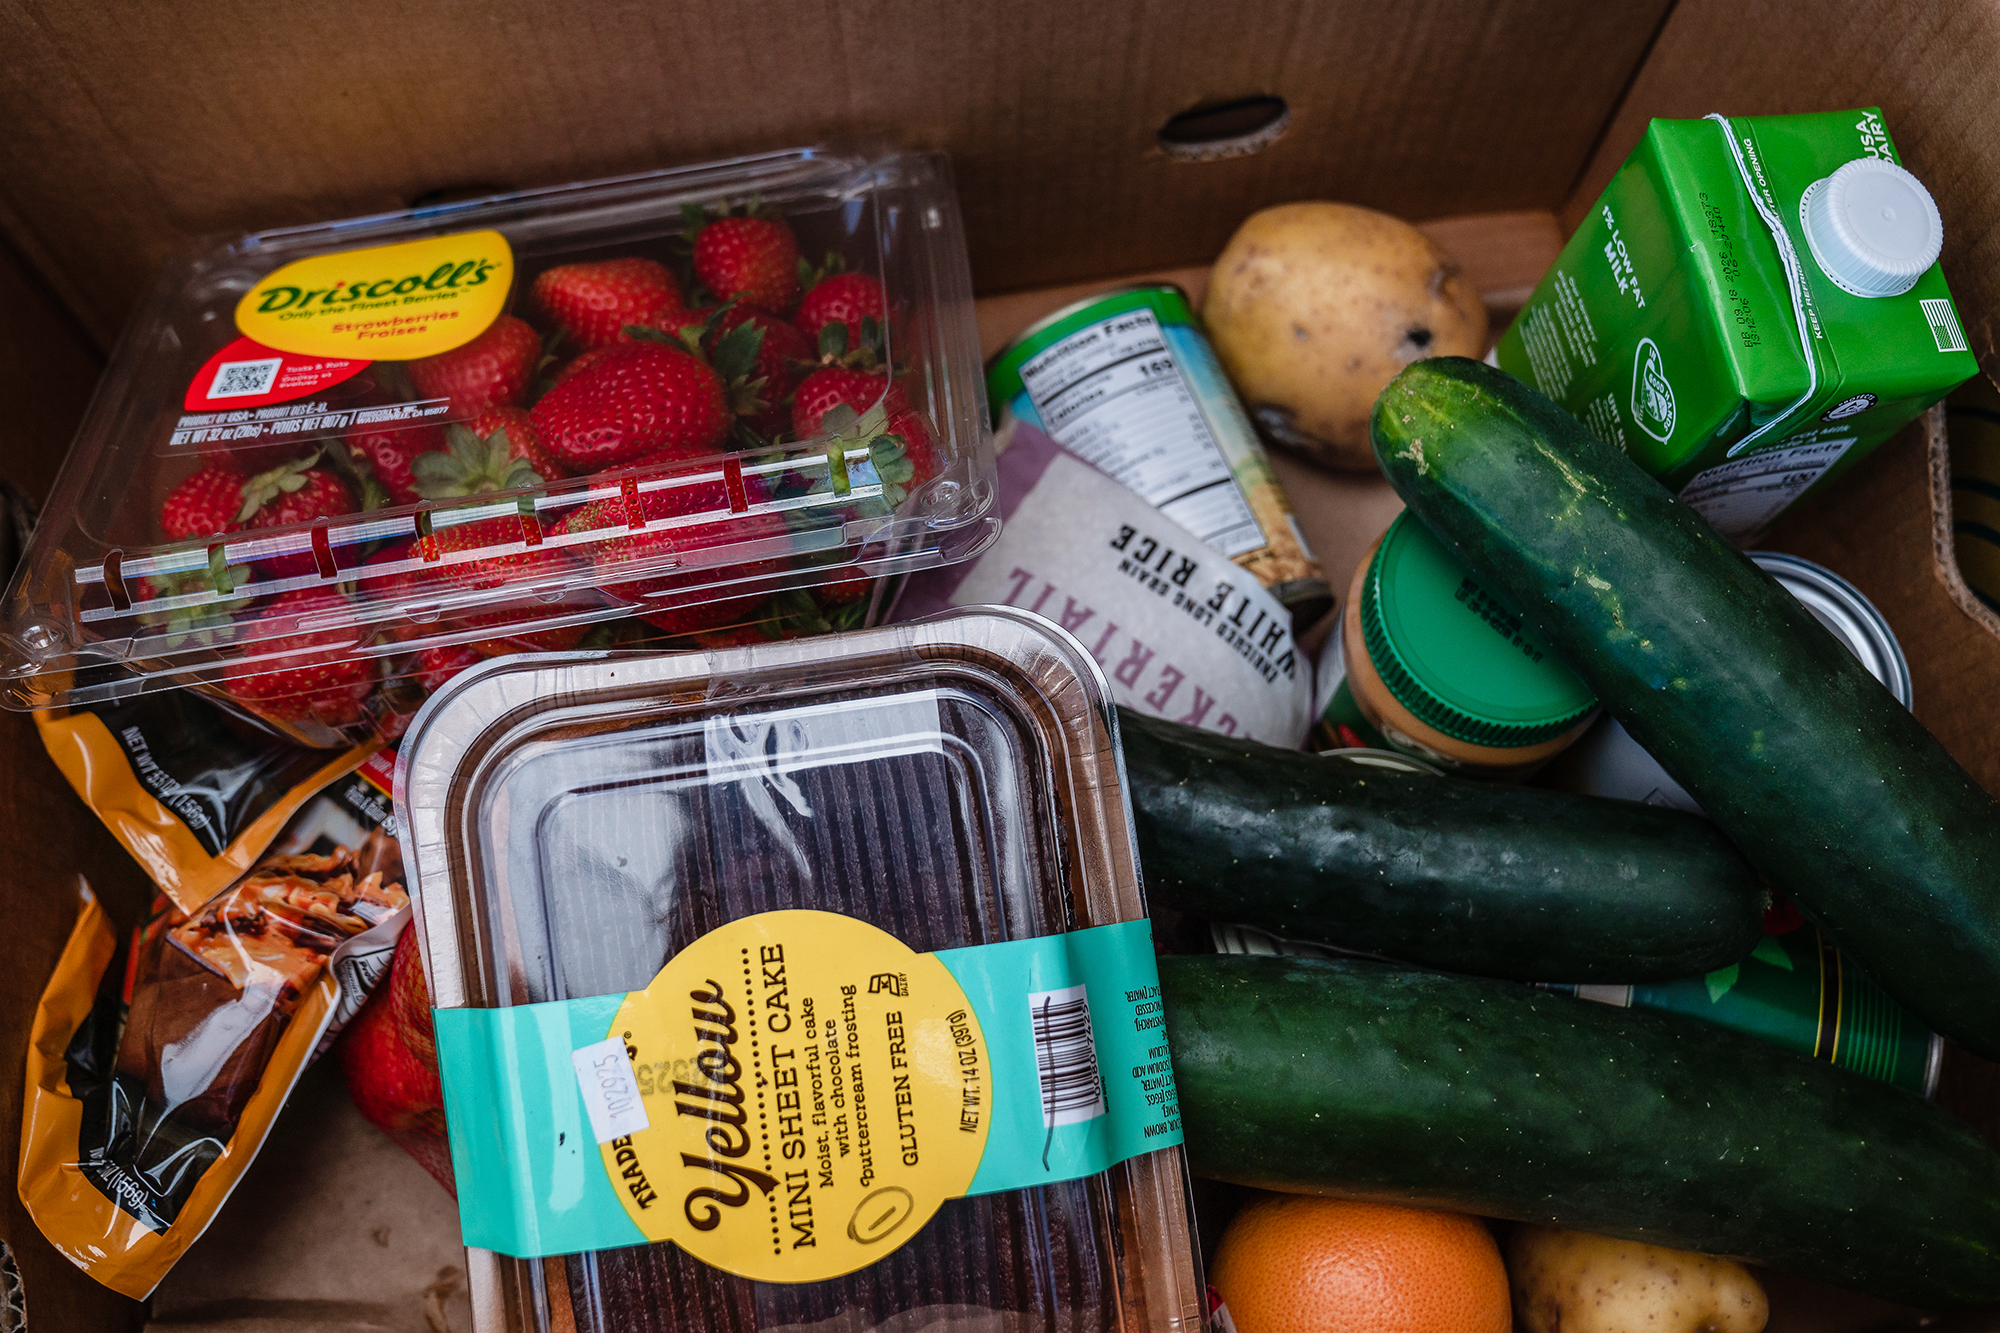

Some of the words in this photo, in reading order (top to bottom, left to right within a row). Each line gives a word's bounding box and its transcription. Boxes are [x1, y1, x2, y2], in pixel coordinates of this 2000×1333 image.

[1855, 119, 1880, 161] USA
[1743, 138, 1767, 188] OPENING
[1602, 205, 1615, 230] 1%
[1612, 229, 1634, 275] LOW
[1629, 275, 1646, 309] FAT
[1604, 241, 1629, 296] MILK
[1719, 251, 1734, 283] 2026
[257, 258, 497, 314] Driscoll's
[278, 309, 317, 322] Only
[319, 305, 346, 317] the
[350, 298, 399, 313] Finest
[331, 310, 460, 333] Strawberries
[1808, 309, 1823, 339] KEEP
[356, 324, 428, 341] Fraises
[1741, 331, 1753, 348] BB
[1648, 346, 1657, 362] IN
[1648, 373, 1665, 394] GOOD
[1838, 393, 1876, 407] PROTECTS
[169, 430, 194, 445] NET
[191, 429, 210, 443] WT
[206, 427, 223, 442] 32
[270, 419, 302, 435] POIDS
[301, 415, 321, 430] NET
[321, 413, 339, 428] 907
[177, 413, 216, 428] PRODUCT
[215, 412, 228, 424] OF
[227, 410, 250, 423] USA
[255, 406, 292, 420] PRODUIT
[412, 408, 424, 418] CA
[1607, 392, 1621, 424] UHT
[1616, 426, 1628, 453] MIL
[1663, 390, 1675, 433] HANDS
[1699, 452, 1784, 481] Nutrition
[1788, 442, 1844, 457] Facts
[1110, 522, 1201, 589] RICE
[1117, 558, 1172, 597] GRAIN
[1171, 590, 1214, 630] LONG
[1205, 580, 1298, 682] WHITE
[1008, 566, 1248, 739] CKERTAIL
[1214, 621, 1280, 686] ENRICHED
[121, 726, 148, 754] NET
[135, 752, 159, 775] WT
[760, 943, 793, 1034] CAKE
[899, 972, 910, 997] DAIRY
[1124, 985, 1148, 1003] [WATER,
[800, 996, 817, 1040] cake
[840, 984, 861, 1059] frosting
[945, 1008, 977, 1047] (397g)
[1083, 1003, 1094, 1045] 7425
[886, 1010, 908, 1070] FREE
[958, 1046, 977, 1065] OZ
[825, 1018, 846, 1109] chocolate
[962, 1067, 980, 1084] 14
[1089, 1056, 1101, 1098] 0080
[1132, 1065, 1147, 1079] ACID
[1141, 1073, 1165, 1092] [WATER,
[672, 978, 781, 1232] Yellow
[771, 1044, 807, 1160] SHEET
[806, 1043, 827, 1127] flavorful
[962, 1085, 981, 1109] WT.
[1144, 1088, 1165, 1106] [EGGS,
[833, 1111, 850, 1158] with
[850, 1061, 876, 1188] buttercream
[893, 1073, 919, 1167] GLUTEN
[959, 1109, 980, 1133] NET
[1143, 1121, 1168, 1139] BROWN
[818, 1130, 835, 1189] Moist,
[106, 1169, 149, 1210] (156g)
[784, 1168, 817, 1250] MINI
